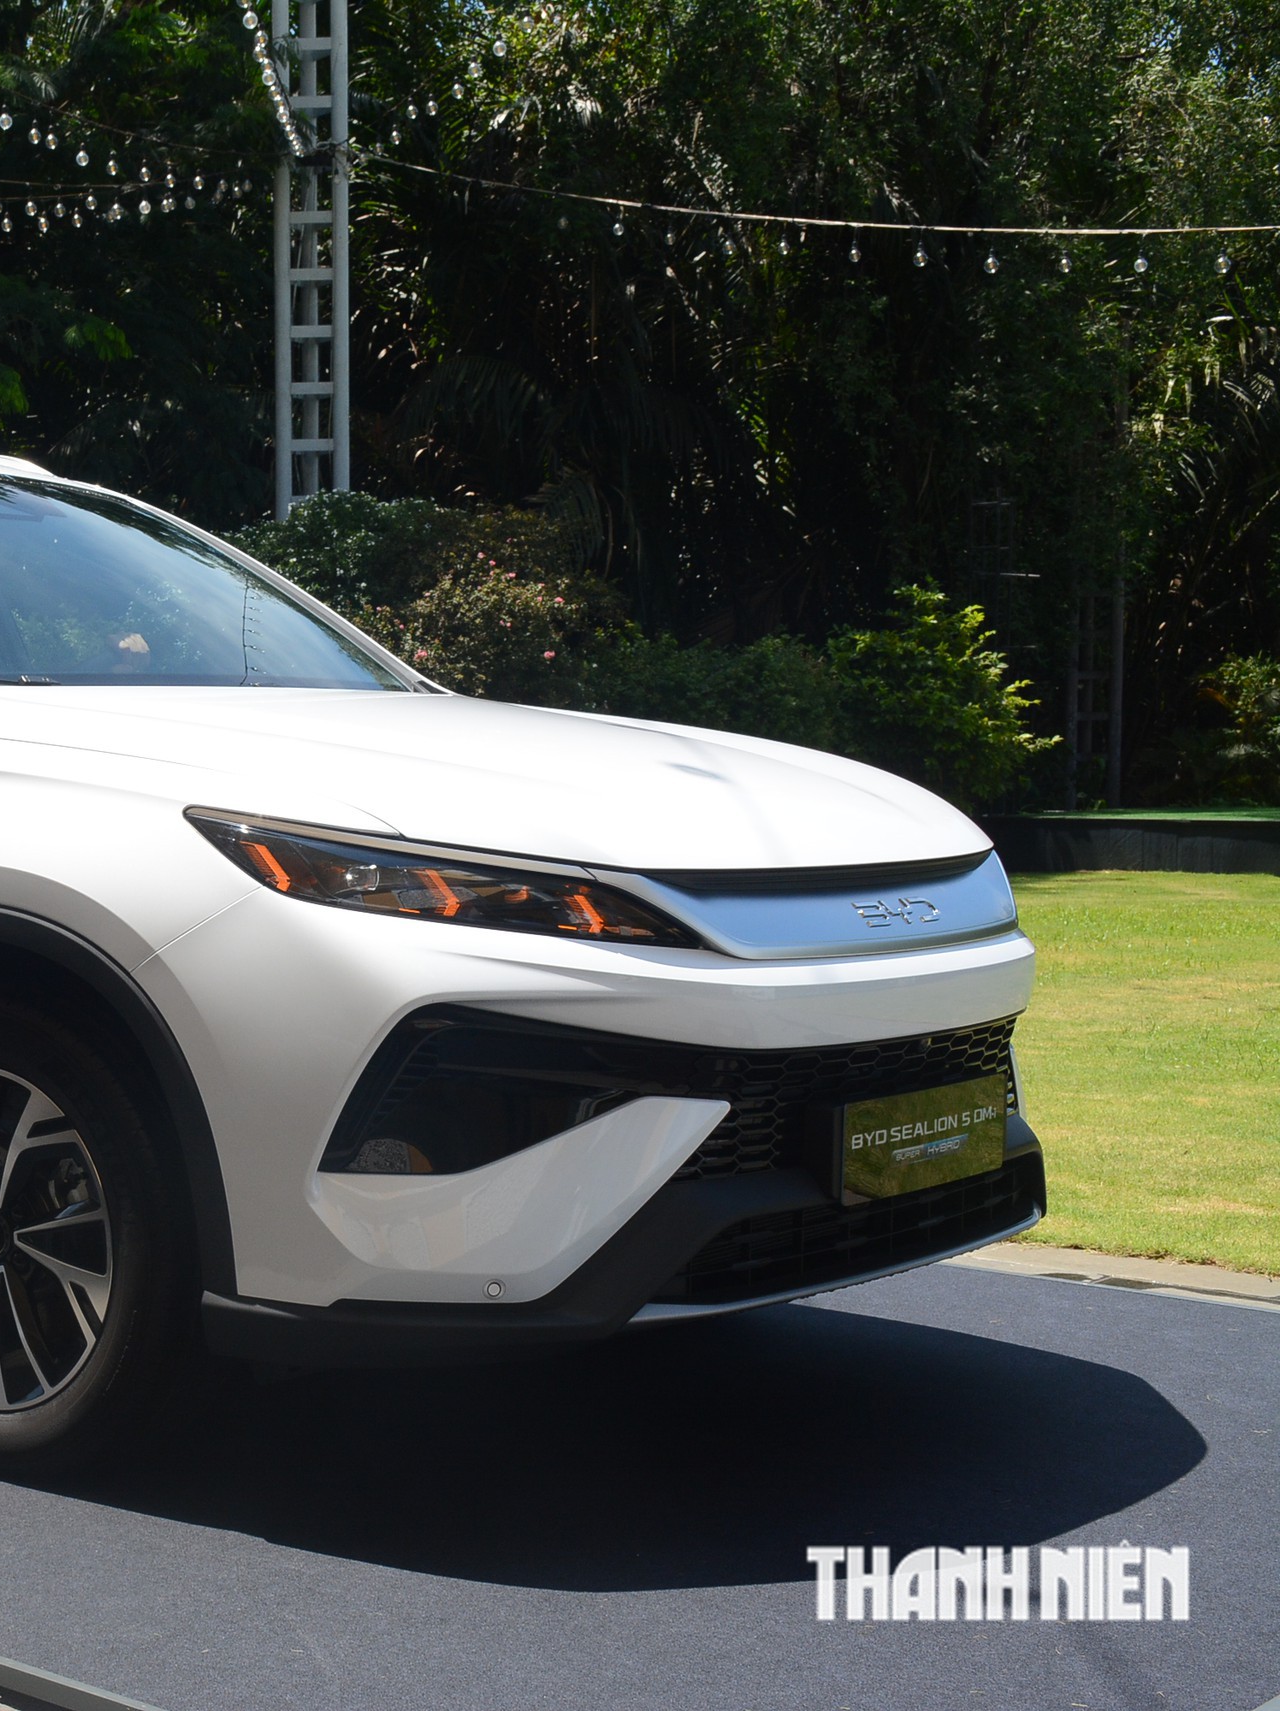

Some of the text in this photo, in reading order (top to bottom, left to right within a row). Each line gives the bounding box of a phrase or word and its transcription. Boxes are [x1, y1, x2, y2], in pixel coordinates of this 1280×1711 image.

[851, 897, 941, 928] BYD
[851, 1129, 888, 1150] BYD
[890, 1114, 958, 1142] SEALION
[961, 1111, 971, 1127] 5
[895, 1139, 961, 1162] SUPER HYBRID
